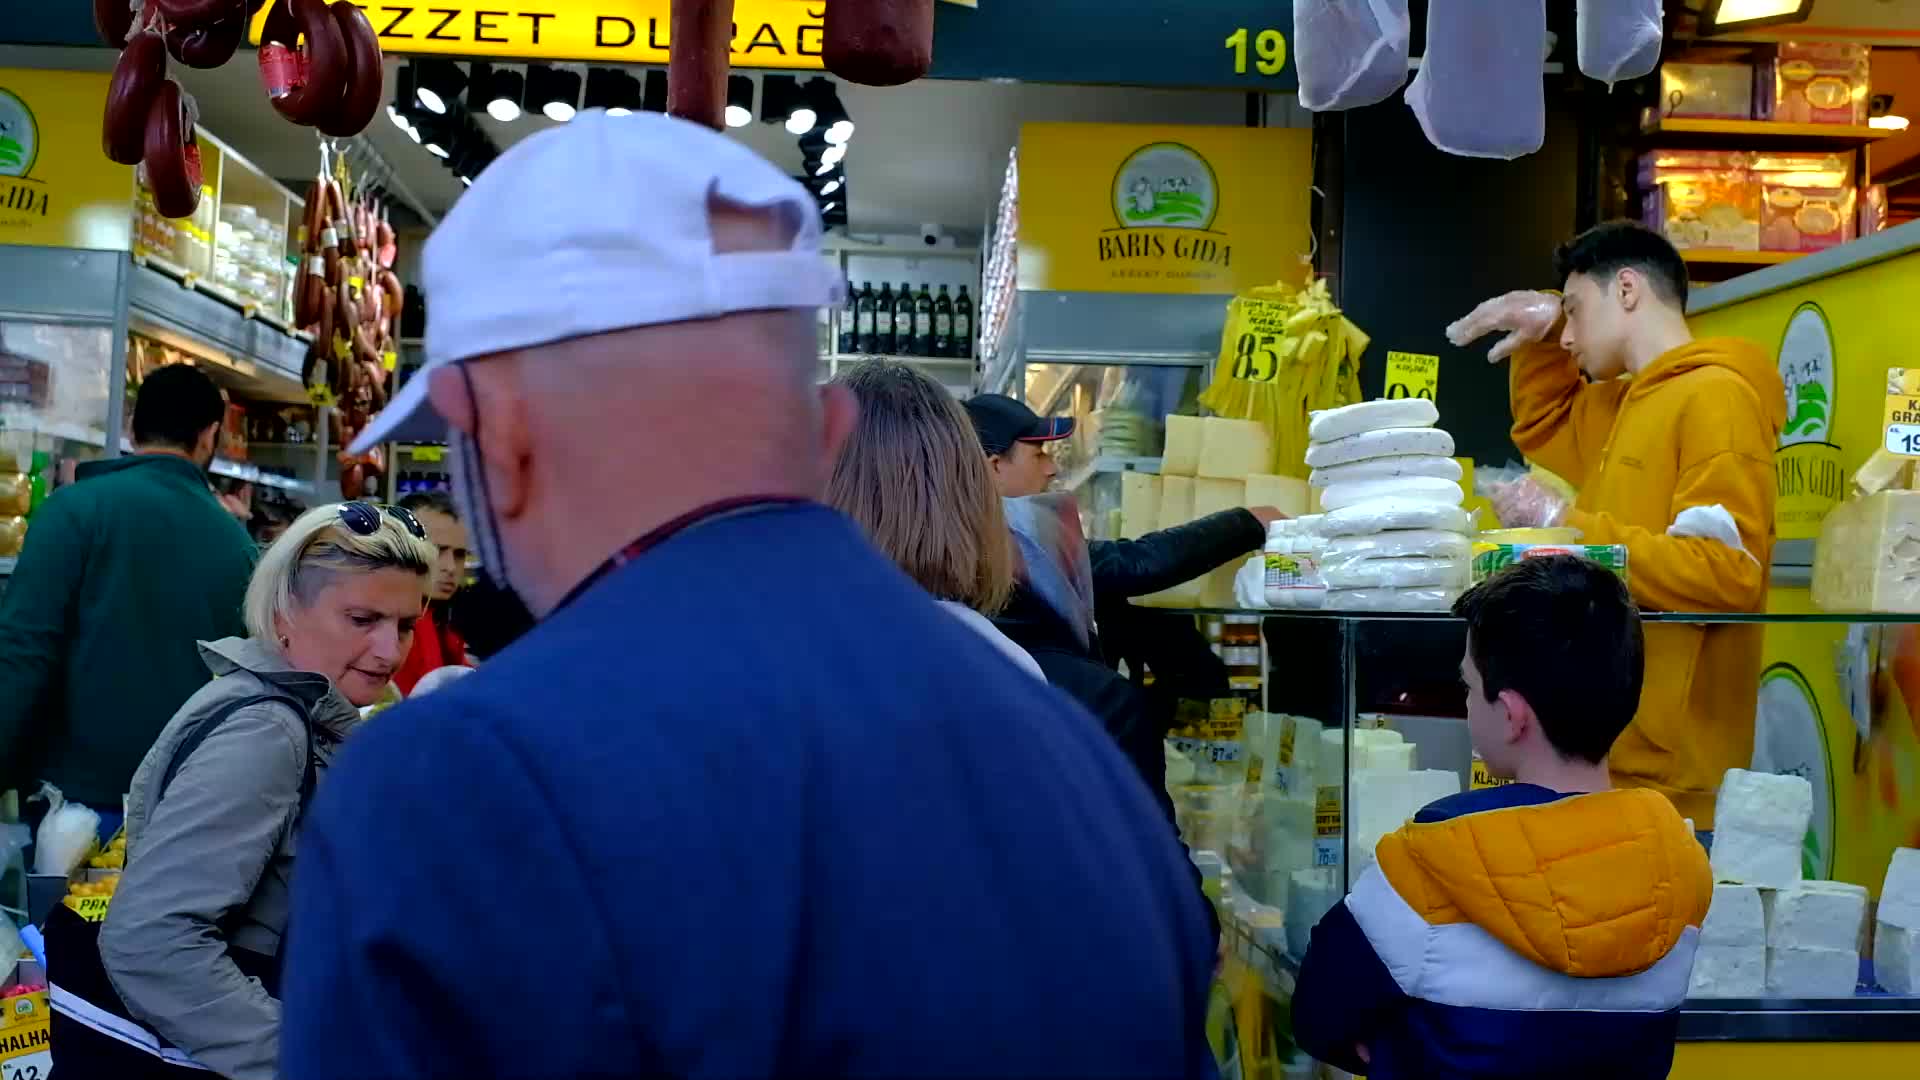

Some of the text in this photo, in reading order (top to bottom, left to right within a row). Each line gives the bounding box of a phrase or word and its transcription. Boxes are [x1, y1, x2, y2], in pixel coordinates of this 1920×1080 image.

[1225, 28, 1287, 75] 19
[1173, 237, 1232, 267] GIDA
[1232, 333, 1278, 382] 85
[1908, 400, 1920, 411] K
